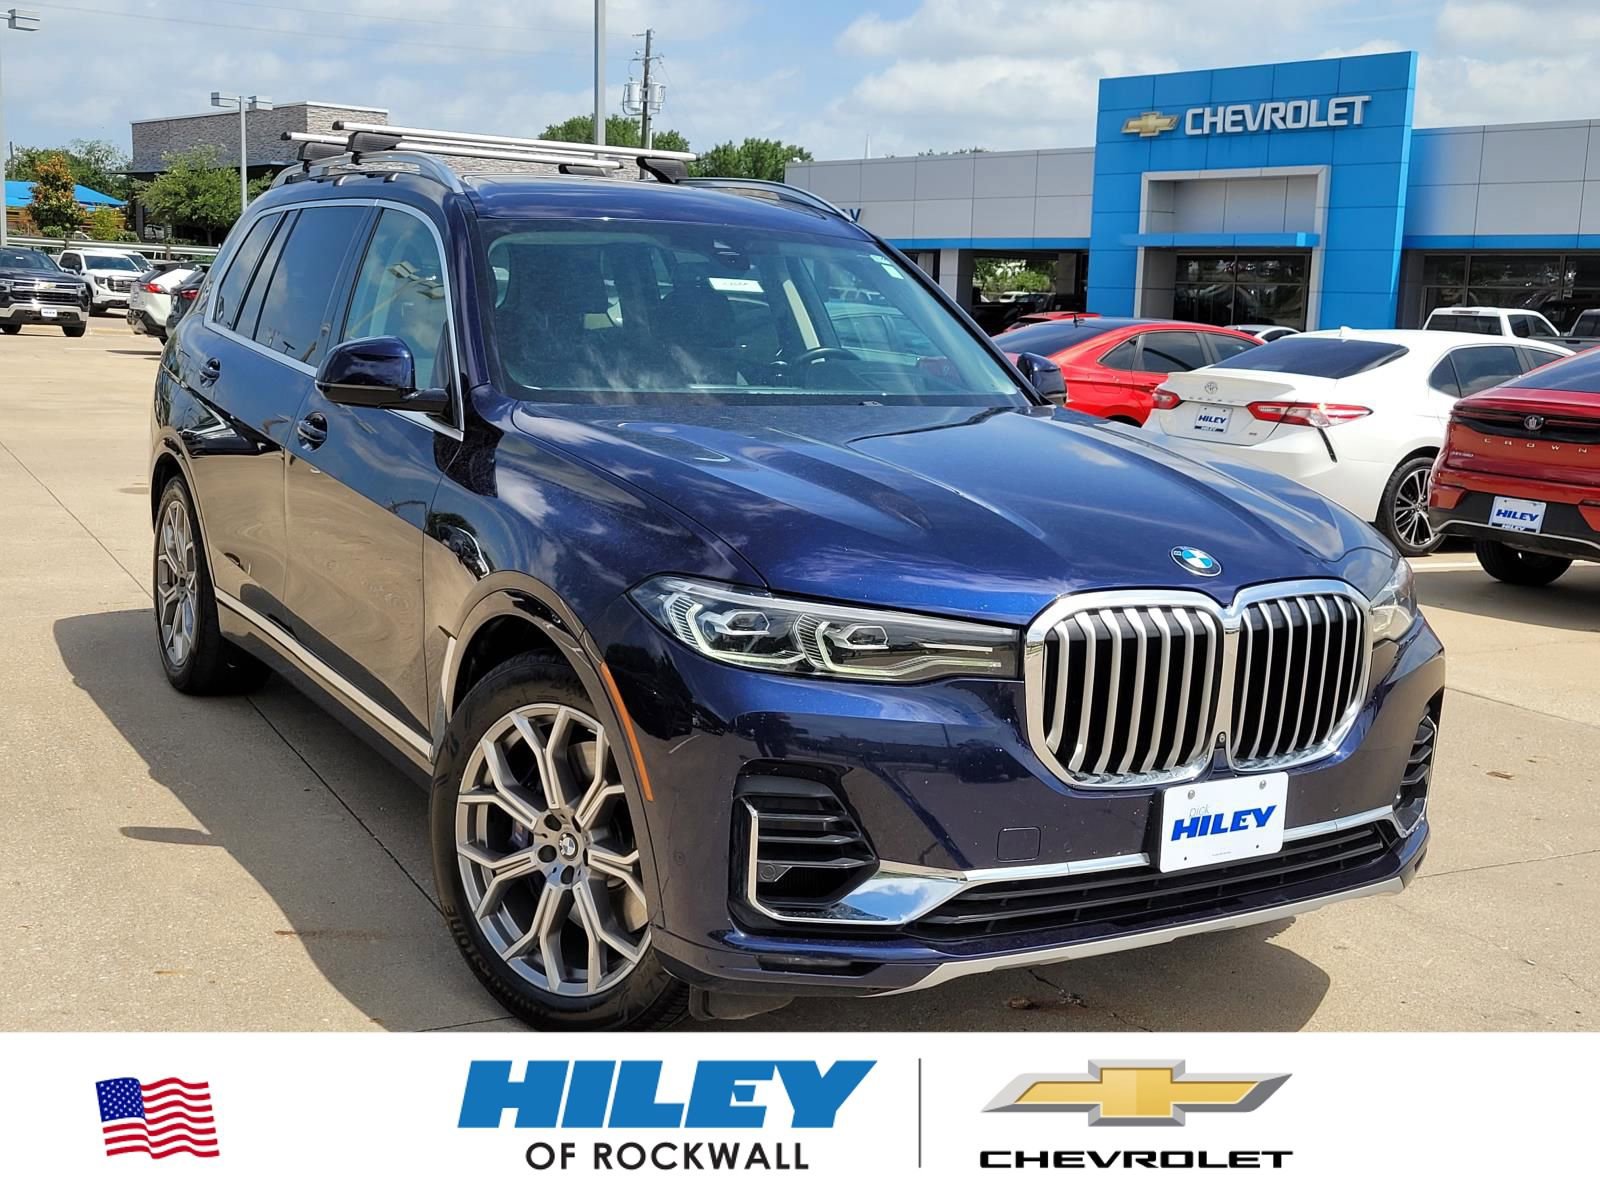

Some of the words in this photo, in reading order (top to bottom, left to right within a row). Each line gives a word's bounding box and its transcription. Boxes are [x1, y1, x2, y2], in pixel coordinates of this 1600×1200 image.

[1185, 96, 1371, 135] CHEVROLET
[1198, 415, 1227, 424] HILEY
[1484, 438, 1588, 453] CROWN
[1496, 509, 1539, 522] HILEY
[1171, 805, 1277, 841] HILEY
